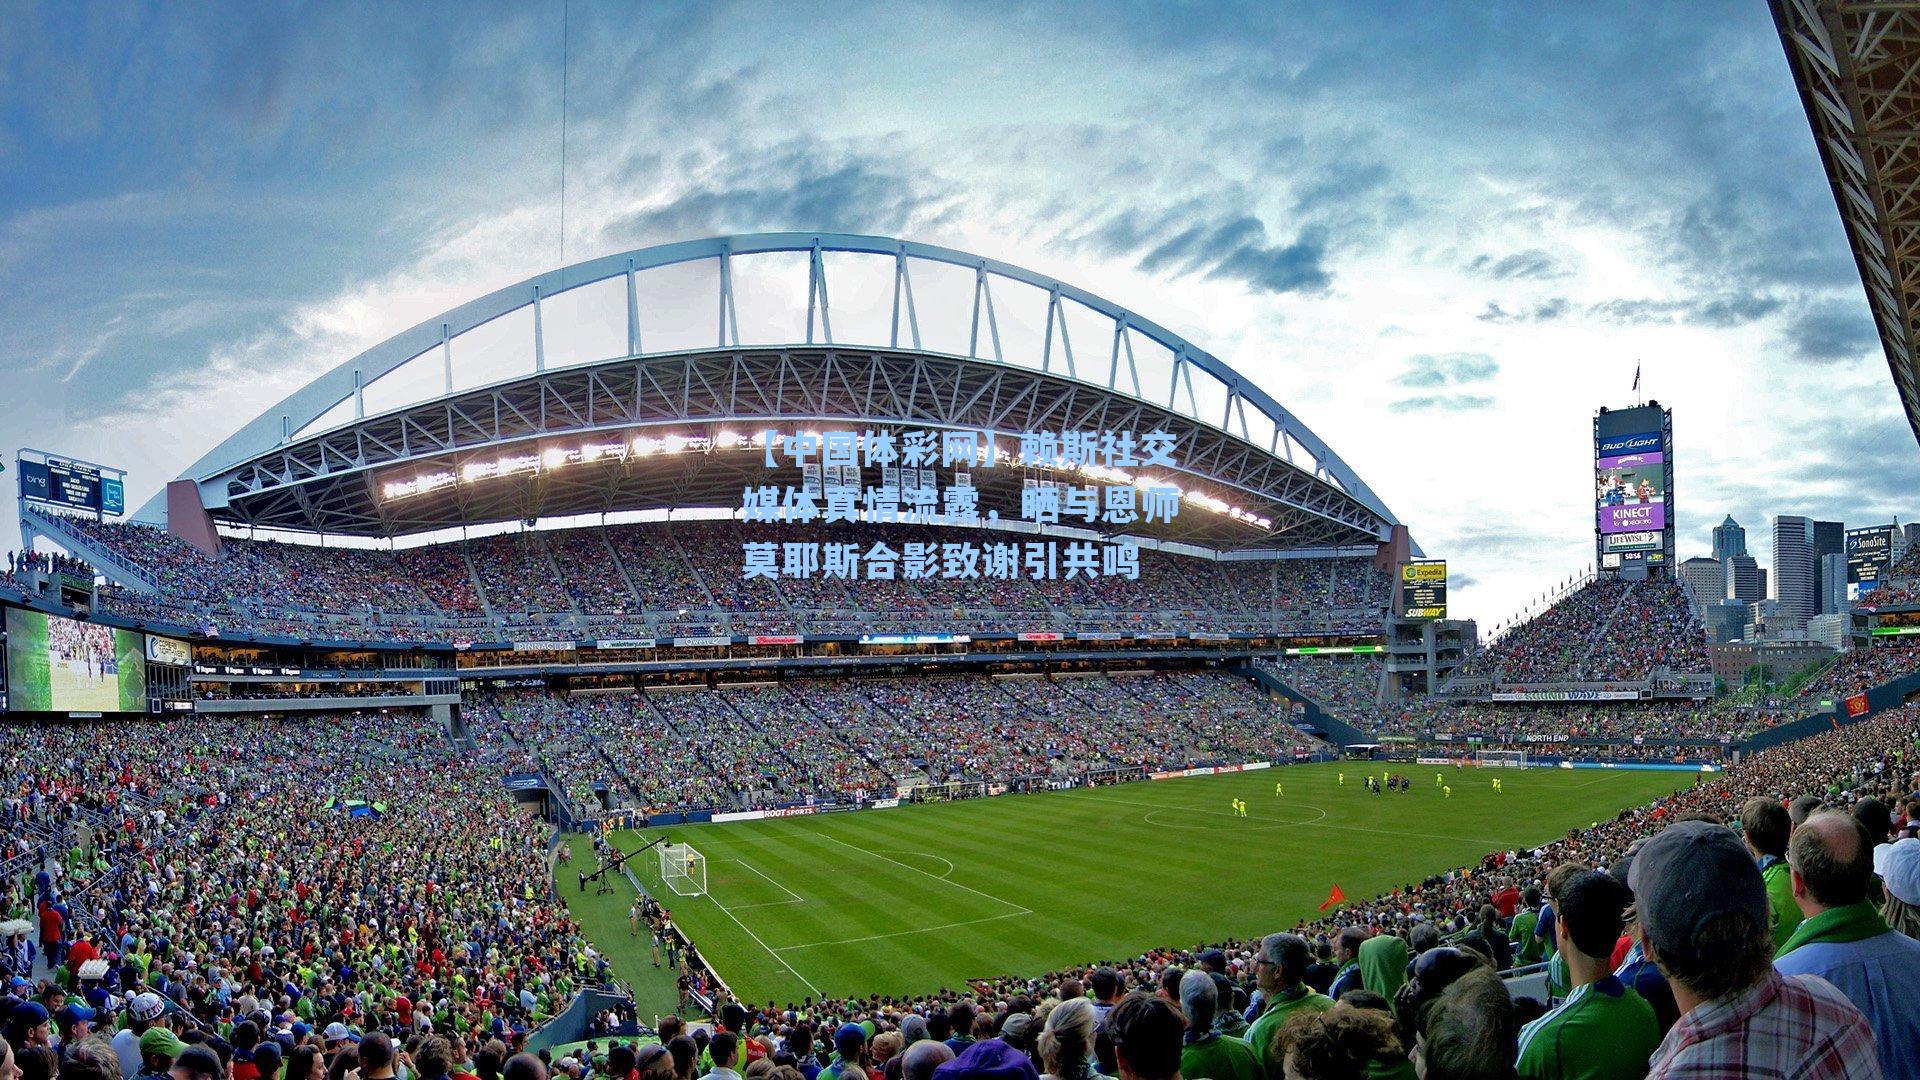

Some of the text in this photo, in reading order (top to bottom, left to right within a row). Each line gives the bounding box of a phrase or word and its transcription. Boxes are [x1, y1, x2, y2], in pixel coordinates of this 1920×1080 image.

[1602, 439, 1658, 450] BUD LIGHT
[26, 475, 46, 487] bing
[1613, 507, 1653, 519] KINECT
[1858, 535, 1887, 548] SonoSite
[1417, 569, 1442, 577] Expedia
[1405, 608, 1445, 617] SUBWAY
[519, 642, 567, 650] PINNACLE
[1526, 734, 1569, 742] NORTH END
[765, 808, 786, 818] ROOT
